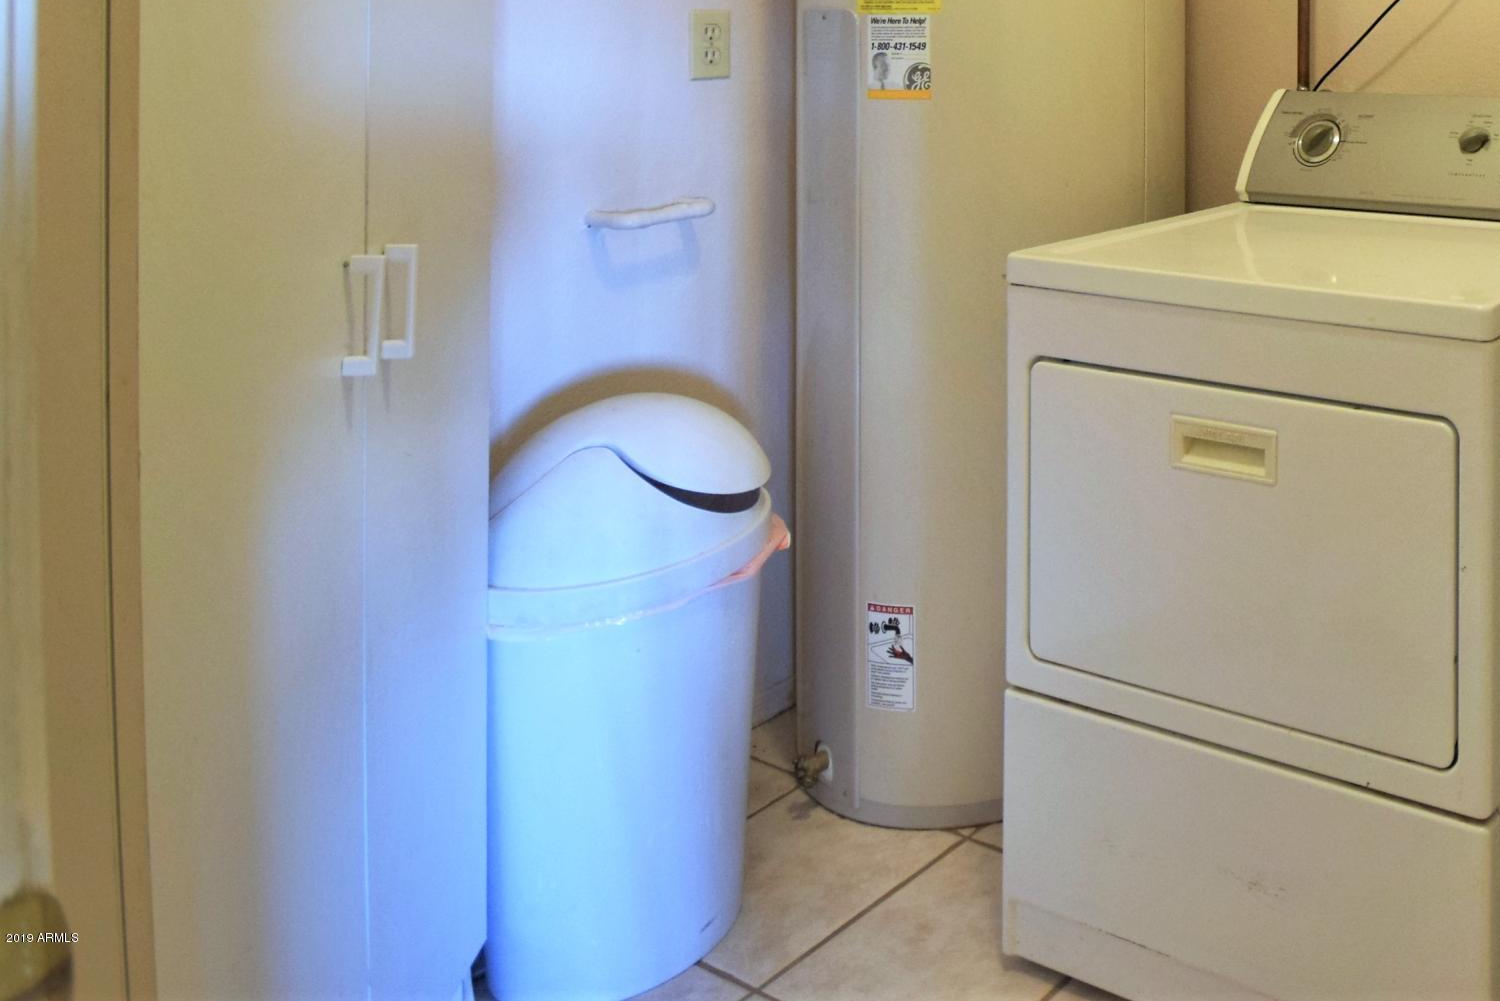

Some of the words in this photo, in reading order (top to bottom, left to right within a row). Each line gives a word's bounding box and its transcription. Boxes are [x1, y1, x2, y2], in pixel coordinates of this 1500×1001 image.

[870, 17, 886, 25] We're
[887, 17, 902, 25] Here
[902, 17, 909, 25] To
[909, 17, 927, 26] Help!
[871, 42, 927, 51] 1-800-431-1549
[876, 605, 911, 614] DANGER
